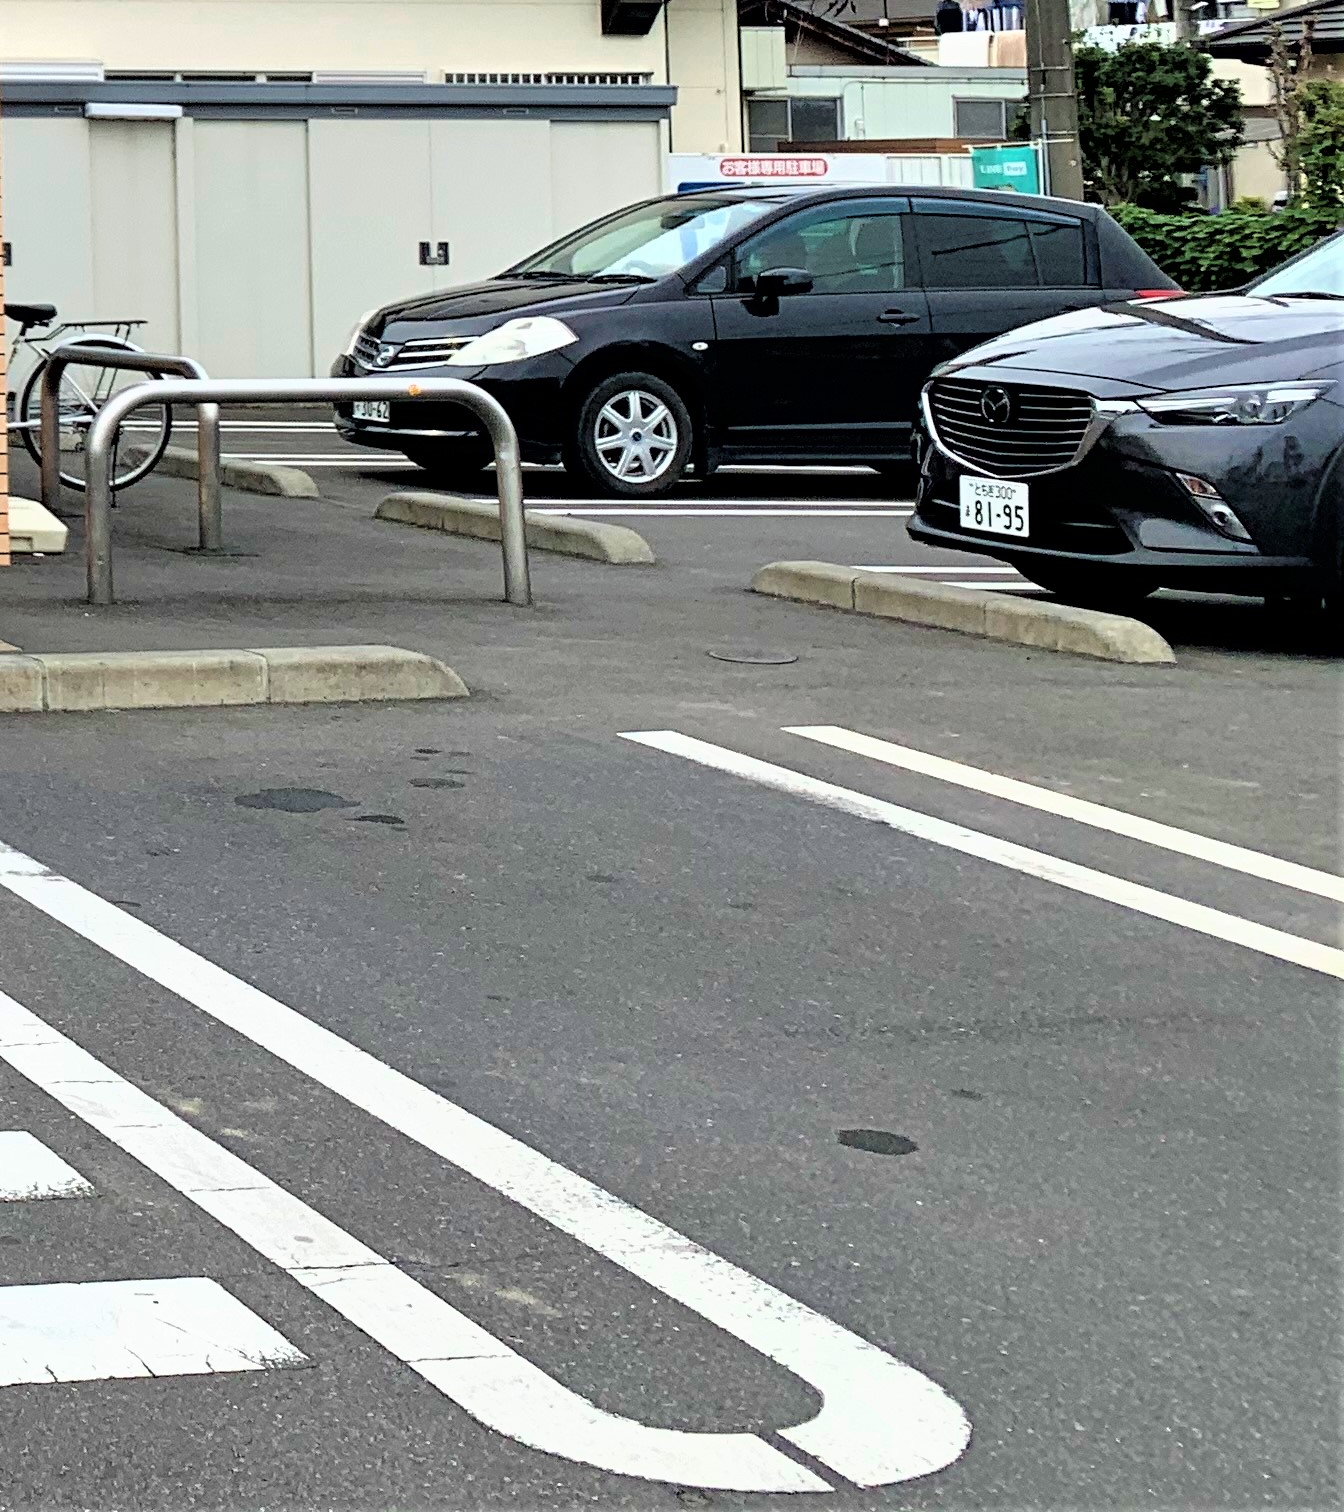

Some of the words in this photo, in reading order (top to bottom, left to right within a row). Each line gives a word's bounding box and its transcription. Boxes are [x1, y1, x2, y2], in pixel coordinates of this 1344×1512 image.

[722, 160, 825, 175] お客様専用駐車場
[975, 500, 1024, 531] 81-95
